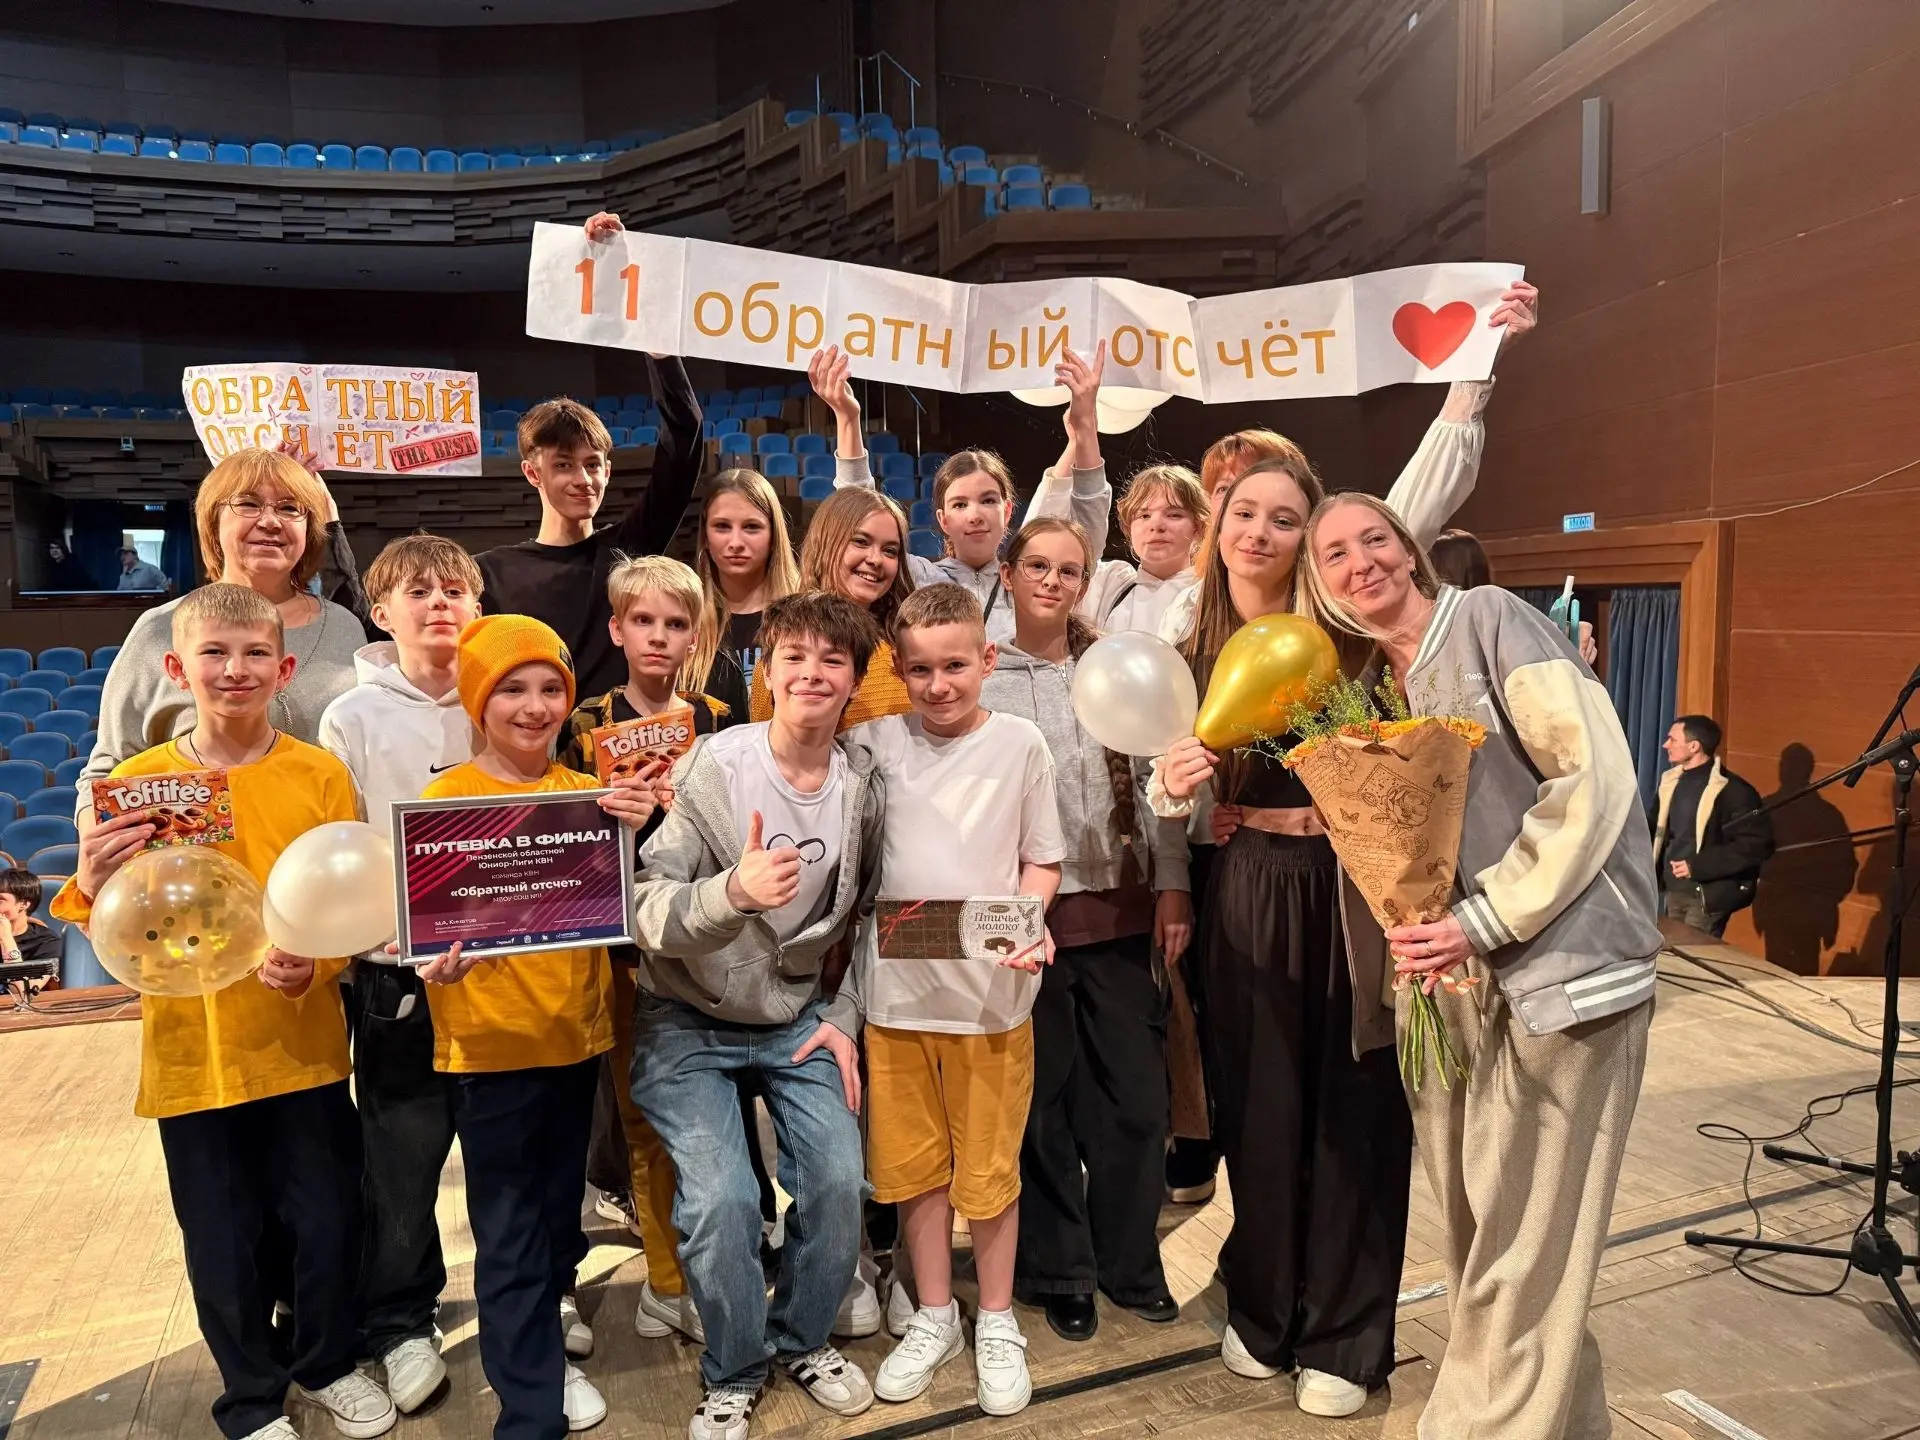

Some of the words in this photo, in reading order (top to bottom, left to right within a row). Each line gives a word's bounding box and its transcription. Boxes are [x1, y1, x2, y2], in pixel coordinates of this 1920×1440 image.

[575, 257, 641, 321] 11
[393, 445, 430, 467] THE
[431, 435, 474, 459] BEST
[600, 722, 690, 760] Toffifee
[107, 779, 212, 812] Toffifee
[414, 836, 512, 856] ПУТЕВКА
[516, 834, 532, 848] В
[535, 829, 611, 845] ФИНАЛ
[466, 850, 519, 862] Пензенской
[519, 847, 565, 857] областной
[478, 858, 533, 870] Юниор-Лиги
[535, 856, 553, 865] КВН
[450, 881, 528, 898] «Обратный
[531, 878, 582, 891] отсчет»
[974, 912, 1020, 922] Птичье
[975, 922, 1018, 931] молоко
